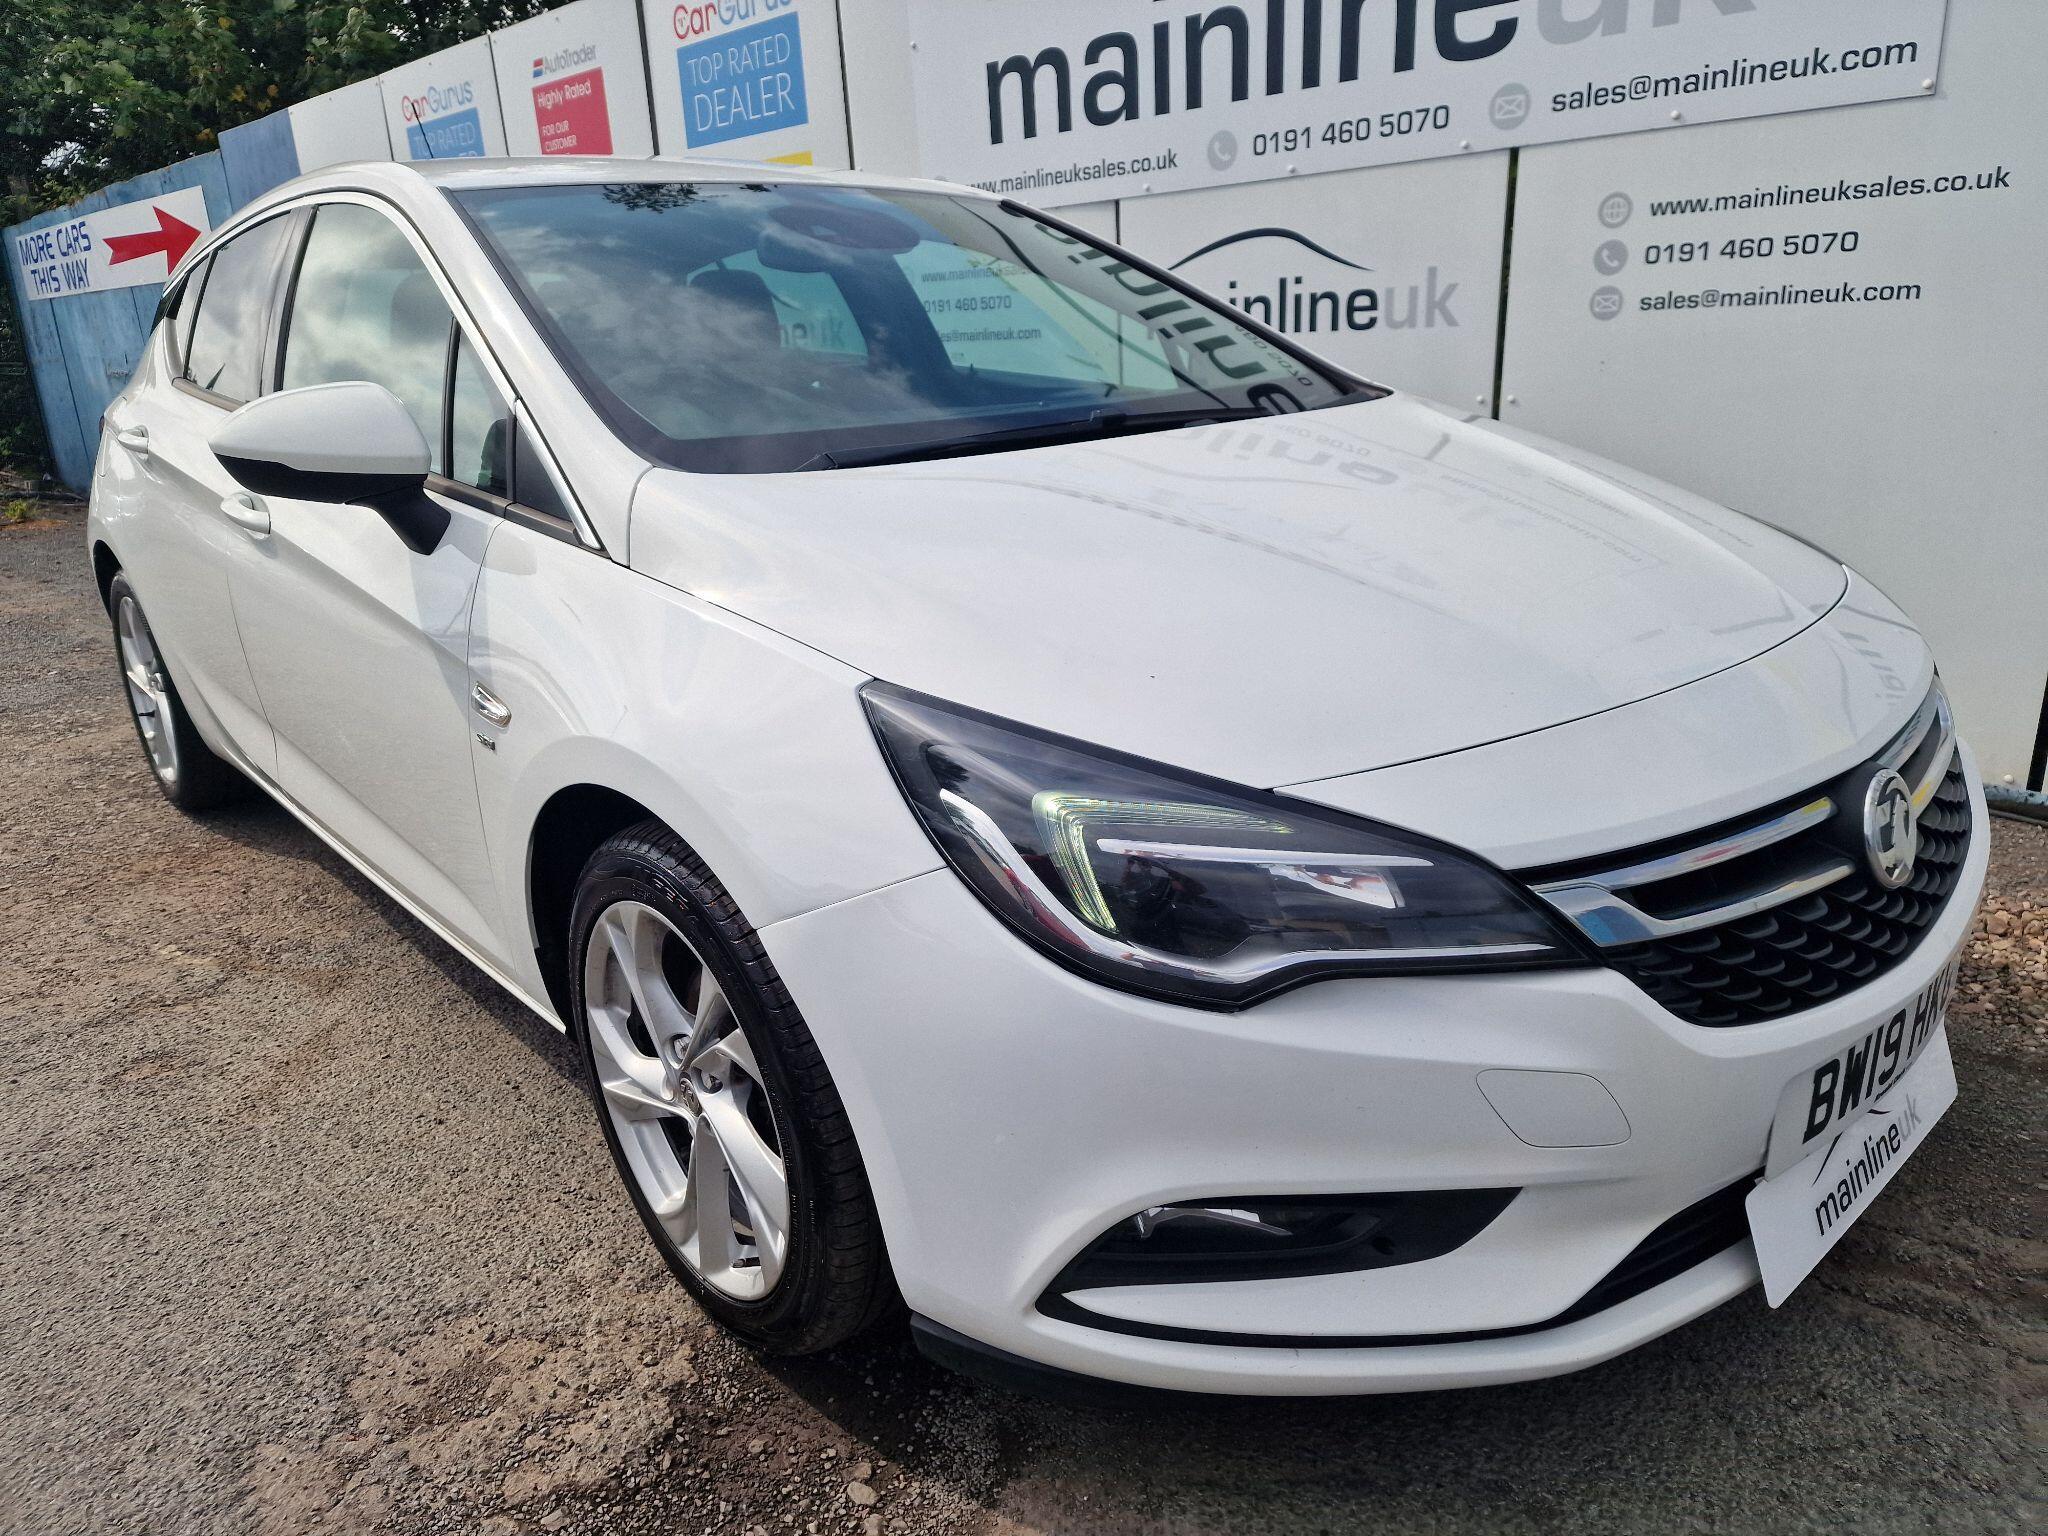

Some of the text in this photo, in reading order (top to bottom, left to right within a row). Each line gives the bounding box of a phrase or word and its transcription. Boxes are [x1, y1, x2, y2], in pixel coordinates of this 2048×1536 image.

[673, 0, 793, 40] CarGur
[687, 33, 791, 86] TOP RATED
[986, 0, 1757, 145] mainline
[1551, 40, 1918, 113] sales@mainlineuk.com
[401, 81, 474, 122] CarGurus
[537, 79, 592, 110] Highly Rated
[694, 72, 796, 132] DEALER
[542, 119, 570, 136] FOR OUR
[545, 134, 578, 152] CUSTOMER
[1253, 104, 1450, 157] 0191 460 5070
[1649, 166, 2011, 217] www.mainlineuksales.co.uk
[18, 220, 92, 267] MORE CARS
[1644, 230, 1860, 266] 0191 460 5070
[30, 257, 91, 296] THIS WAY
[1639, 281, 1922, 312] sales@mainlineuk.com
[955, 297, 978, 312] 460
[980, 295, 1012, 310] 5070
[1802, 1008, 1907, 1144] BW19
[1814, 1093, 1922, 1237] mainlineuk
